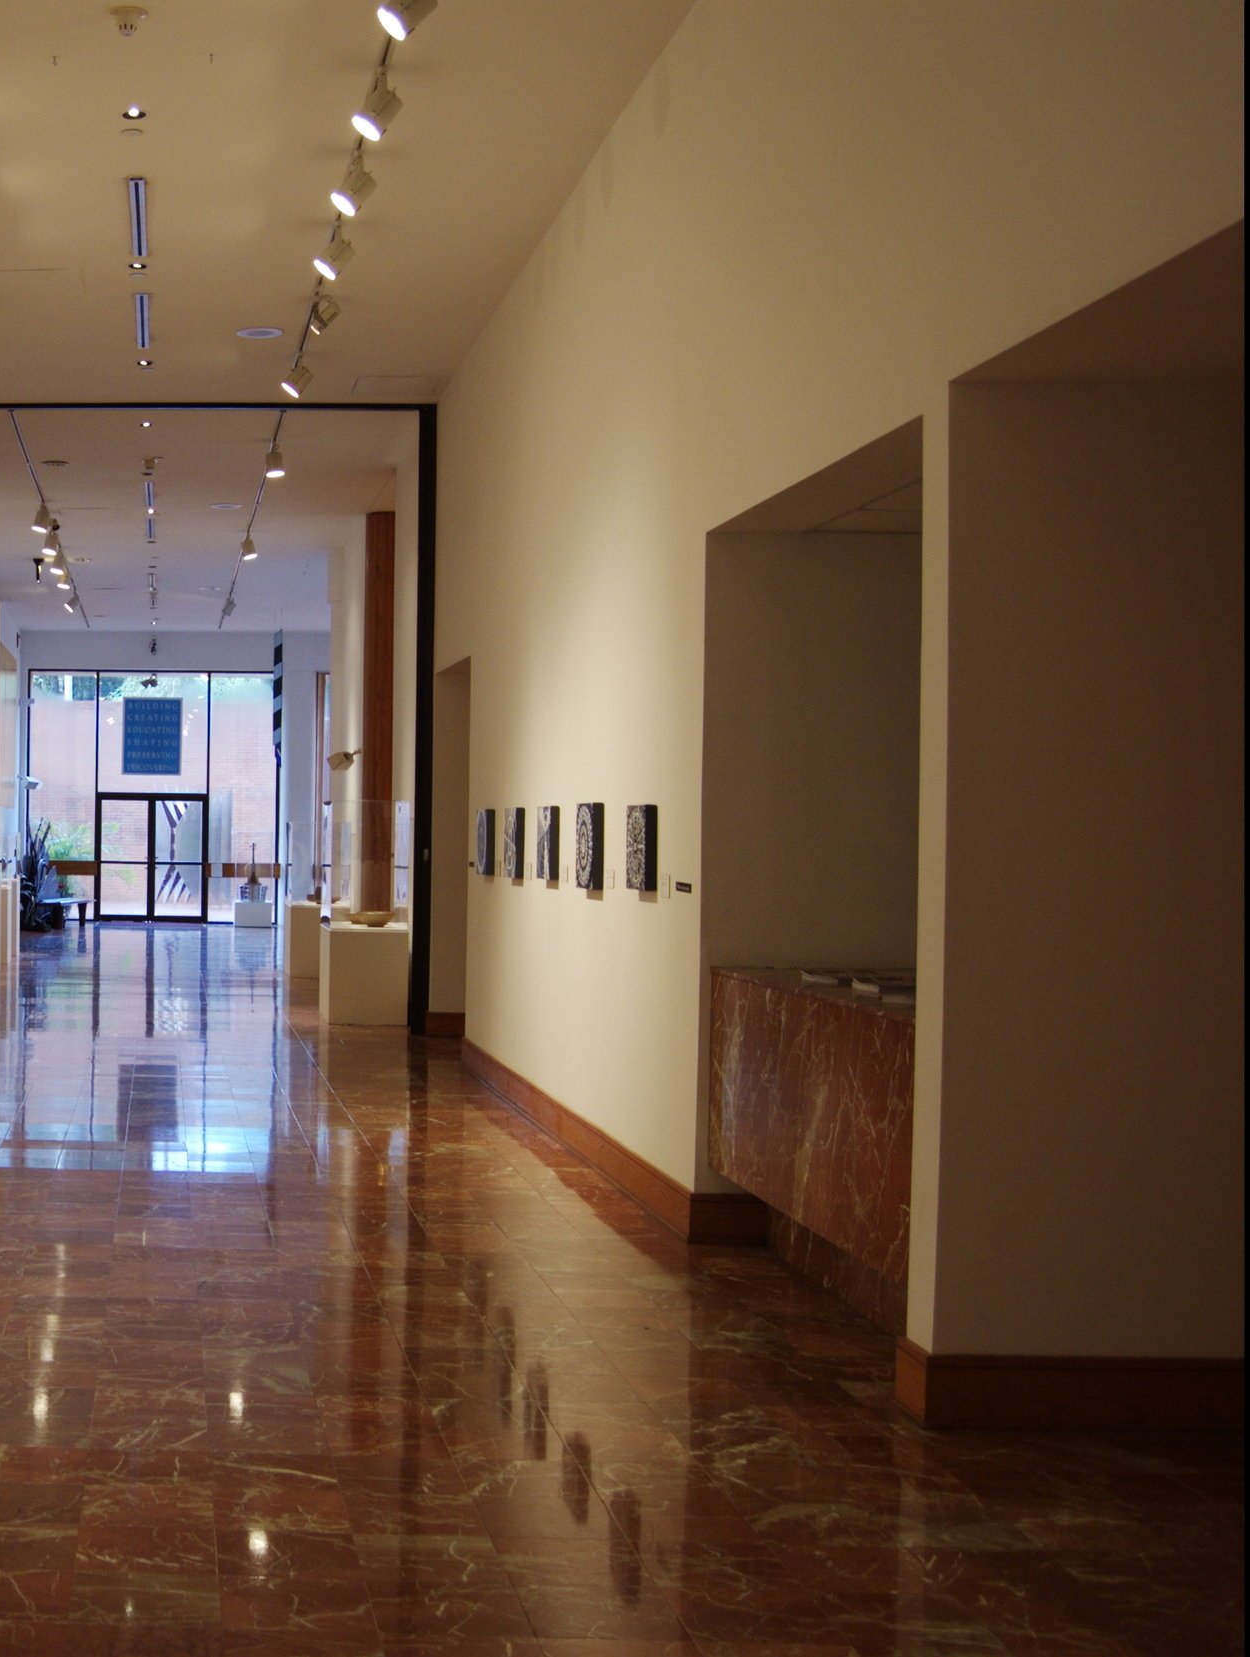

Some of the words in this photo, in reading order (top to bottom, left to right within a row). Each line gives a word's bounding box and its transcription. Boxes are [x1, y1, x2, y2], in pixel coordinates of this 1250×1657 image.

[127, 702, 178, 710] BUILDING
[127, 714, 178, 722] CREATING
[127, 726, 178, 734] EDUCATING
[127, 738, 178, 746] SHAPING
[127, 751, 177, 759] PRESERVING
[127, 763, 177, 771] DISCOVERING
